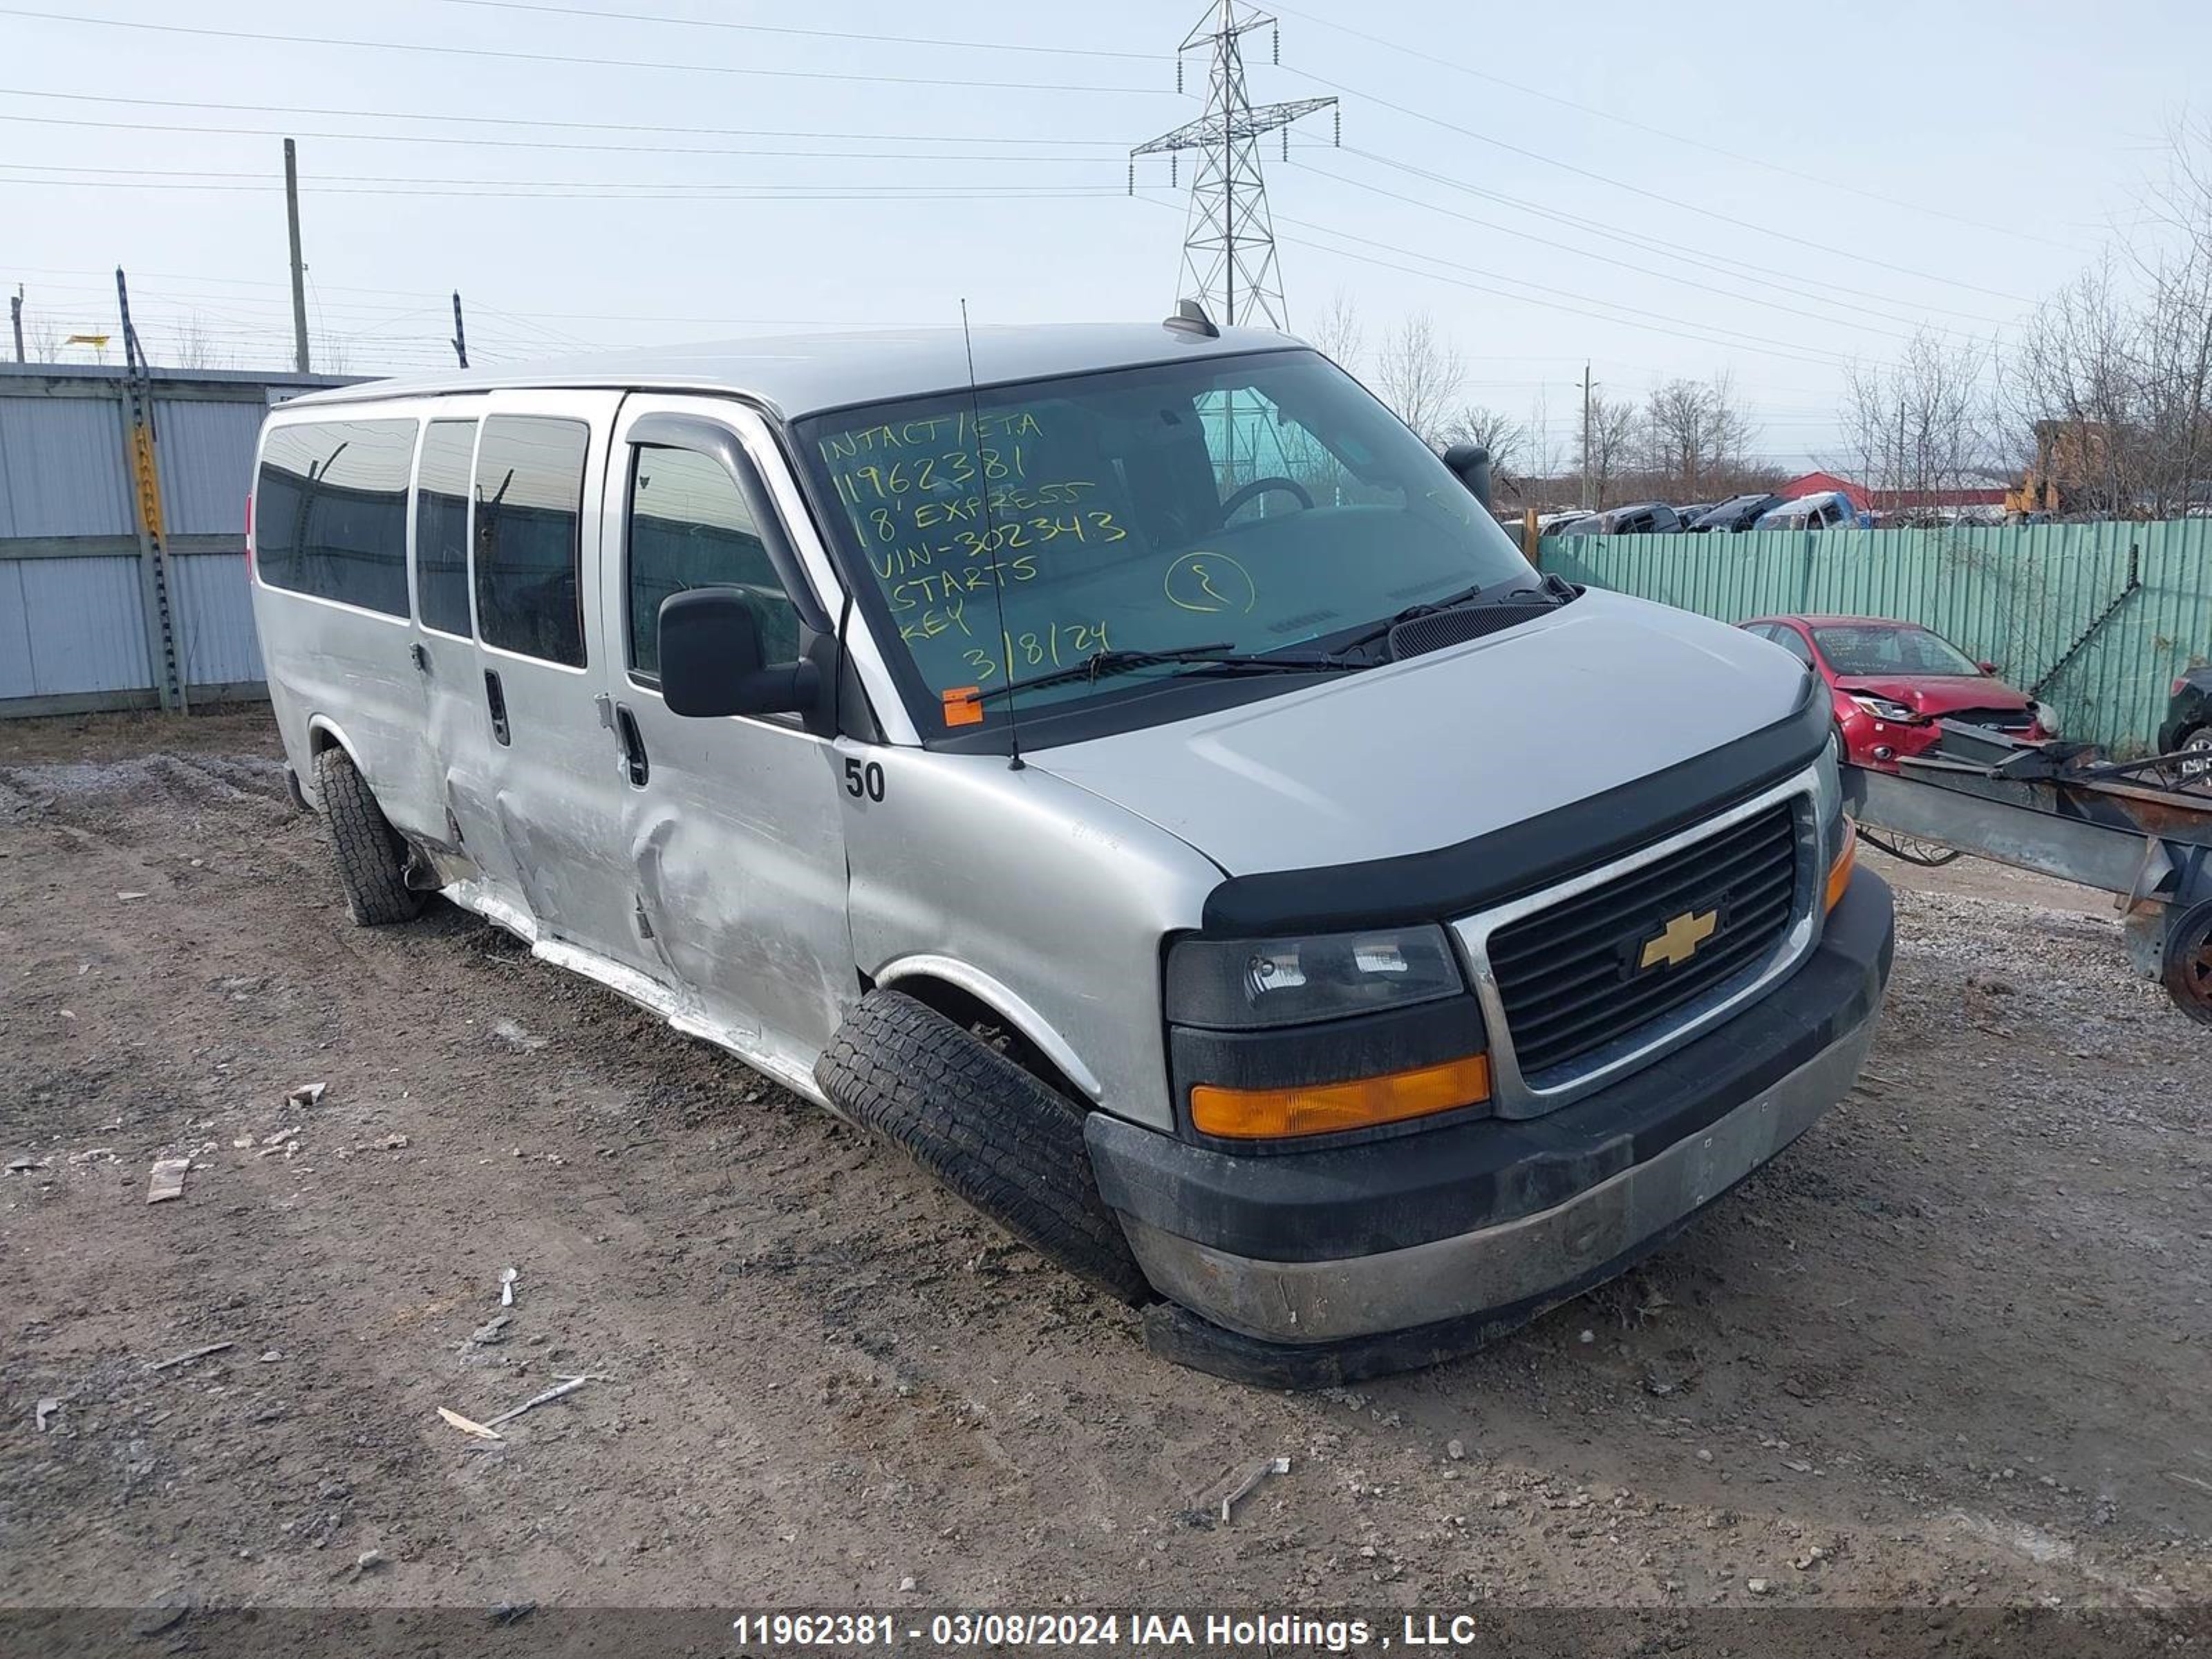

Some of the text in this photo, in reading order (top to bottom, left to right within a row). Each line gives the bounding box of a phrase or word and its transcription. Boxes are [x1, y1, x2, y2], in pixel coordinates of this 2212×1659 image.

[832, 446, 1027, 505] 11962381
[889, 555, 1038, 612] STARTS
[901, 599, 972, 648] KEY
[845, 757, 885, 803] 50
